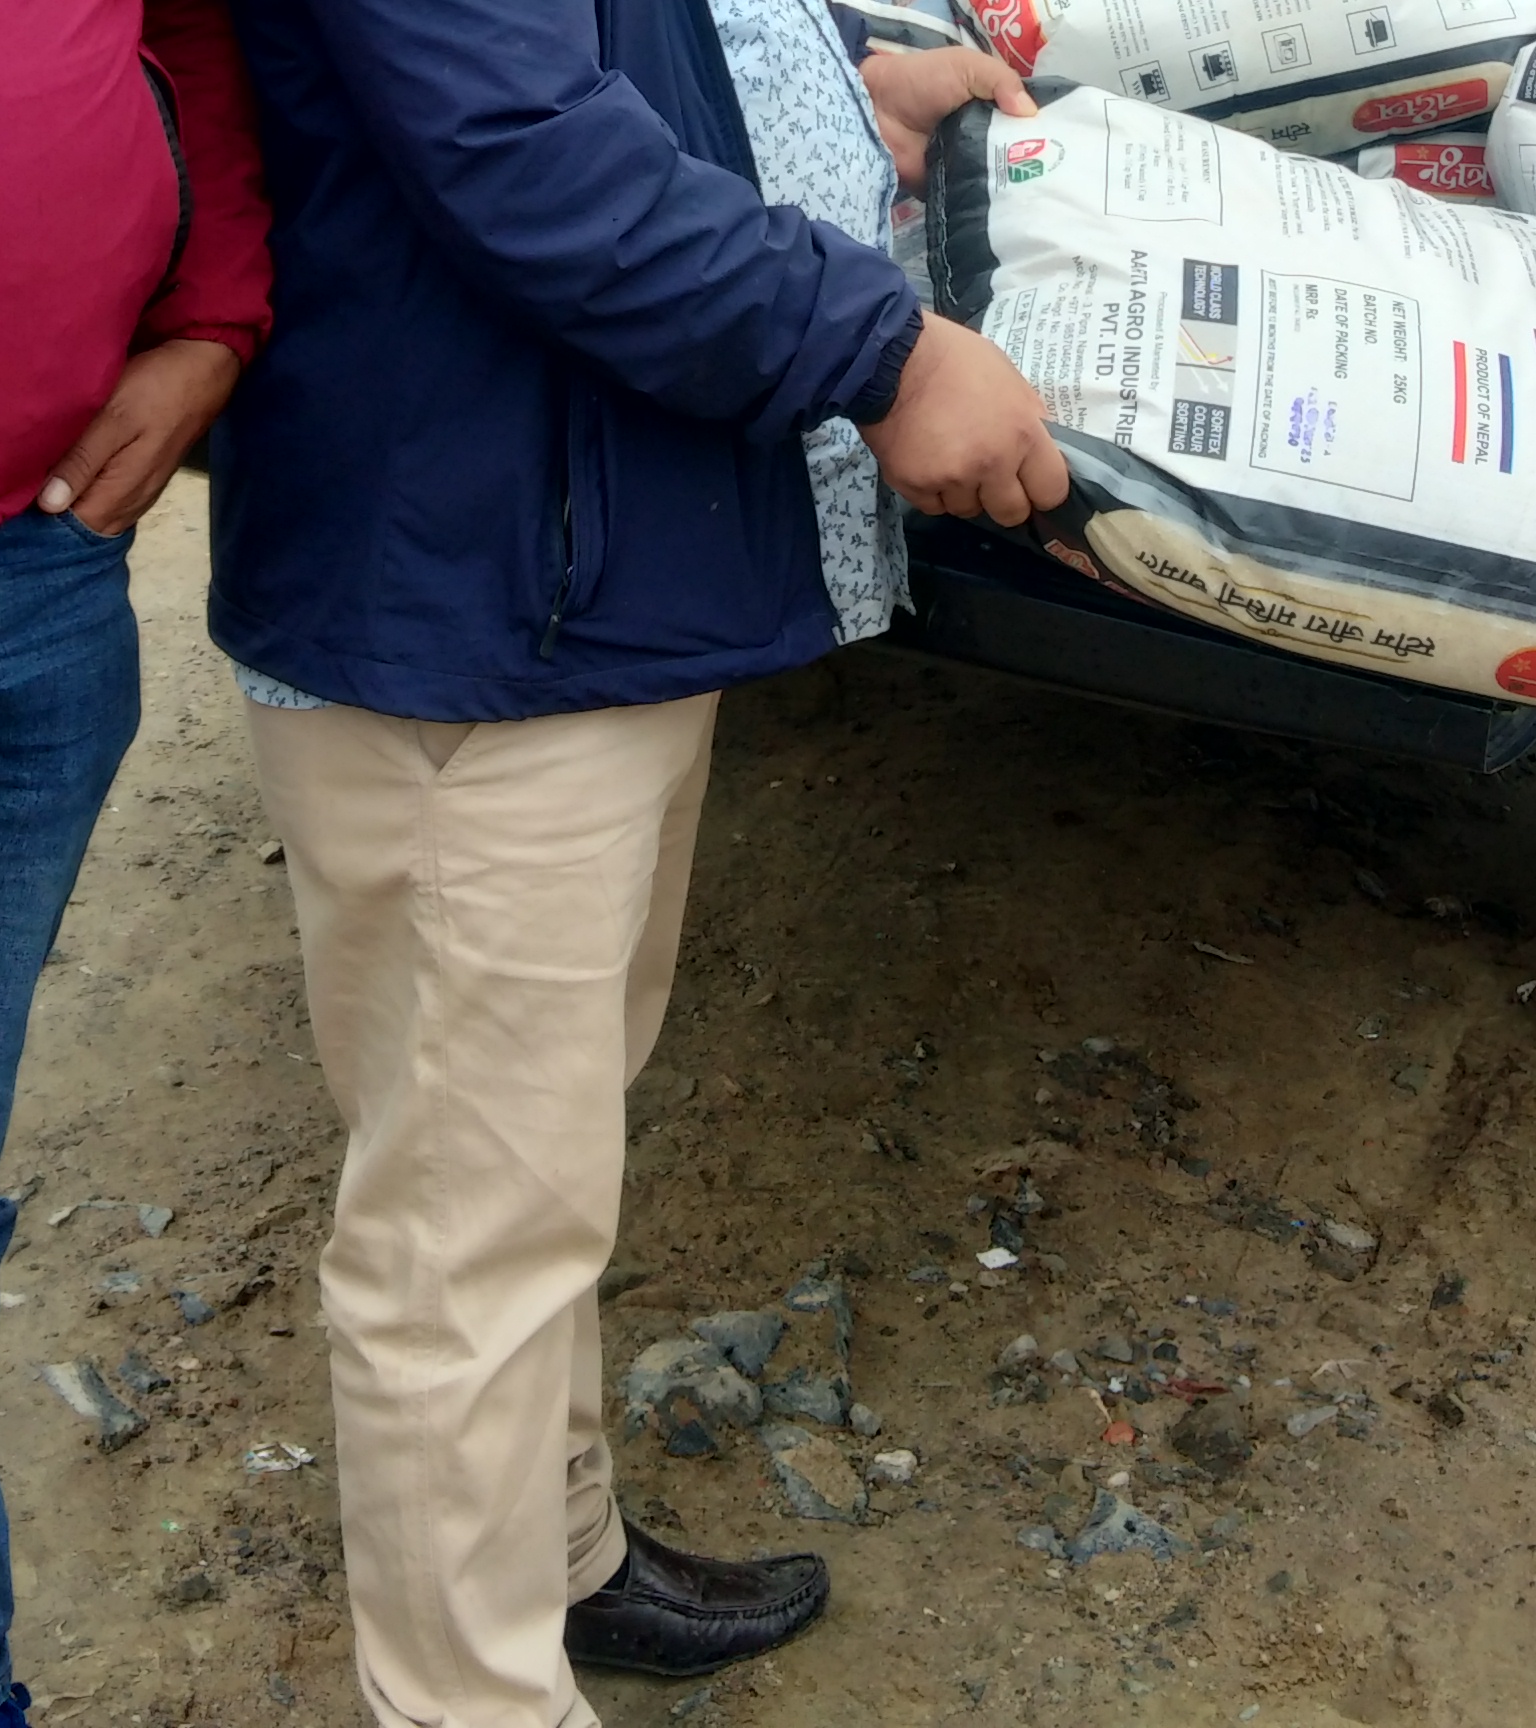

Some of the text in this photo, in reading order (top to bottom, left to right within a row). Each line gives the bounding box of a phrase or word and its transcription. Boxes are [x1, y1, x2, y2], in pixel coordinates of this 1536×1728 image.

[1523, 70, 1536, 100] WORLD
[1359, 91, 1482, 126] नक्षत्र
[1193, 265, 1207, 316] TECHNOLOGY
[1208, 292, 1222, 320] CLASS
[1392, 300, 1407, 320] NET
[1124, 289, 1147, 341] AGRO
[1333, 288, 1349, 380] DATE OF PACKING
[1363, 294, 1378, 345] BATCH NO.
[1094, 302, 1120, 381] PVT. LTD.
[1265, 351, 1276, 373] FROM
[1114, 345, 1142, 449] INDUSTRIE
[1148, 382, 1160, 391] by
[1262, 388, 1273, 409] DATE
[1264, 373, 1274, 387] THE
[1393, 373, 1408, 405] 25KG
[1172, 401, 1190, 452] SORTING
[1261, 409, 1272, 421] OF
[1474, 346, 1490, 466] PRODUCT OF NEPAL
[1190, 404, 1208, 453] COLOUR
[1207, 408, 1225, 455] SORTEX
[1257, 422, 1270, 459] PACKING
[1135, 551, 1436, 658] स्टीम जीरा मसिनो चामल
